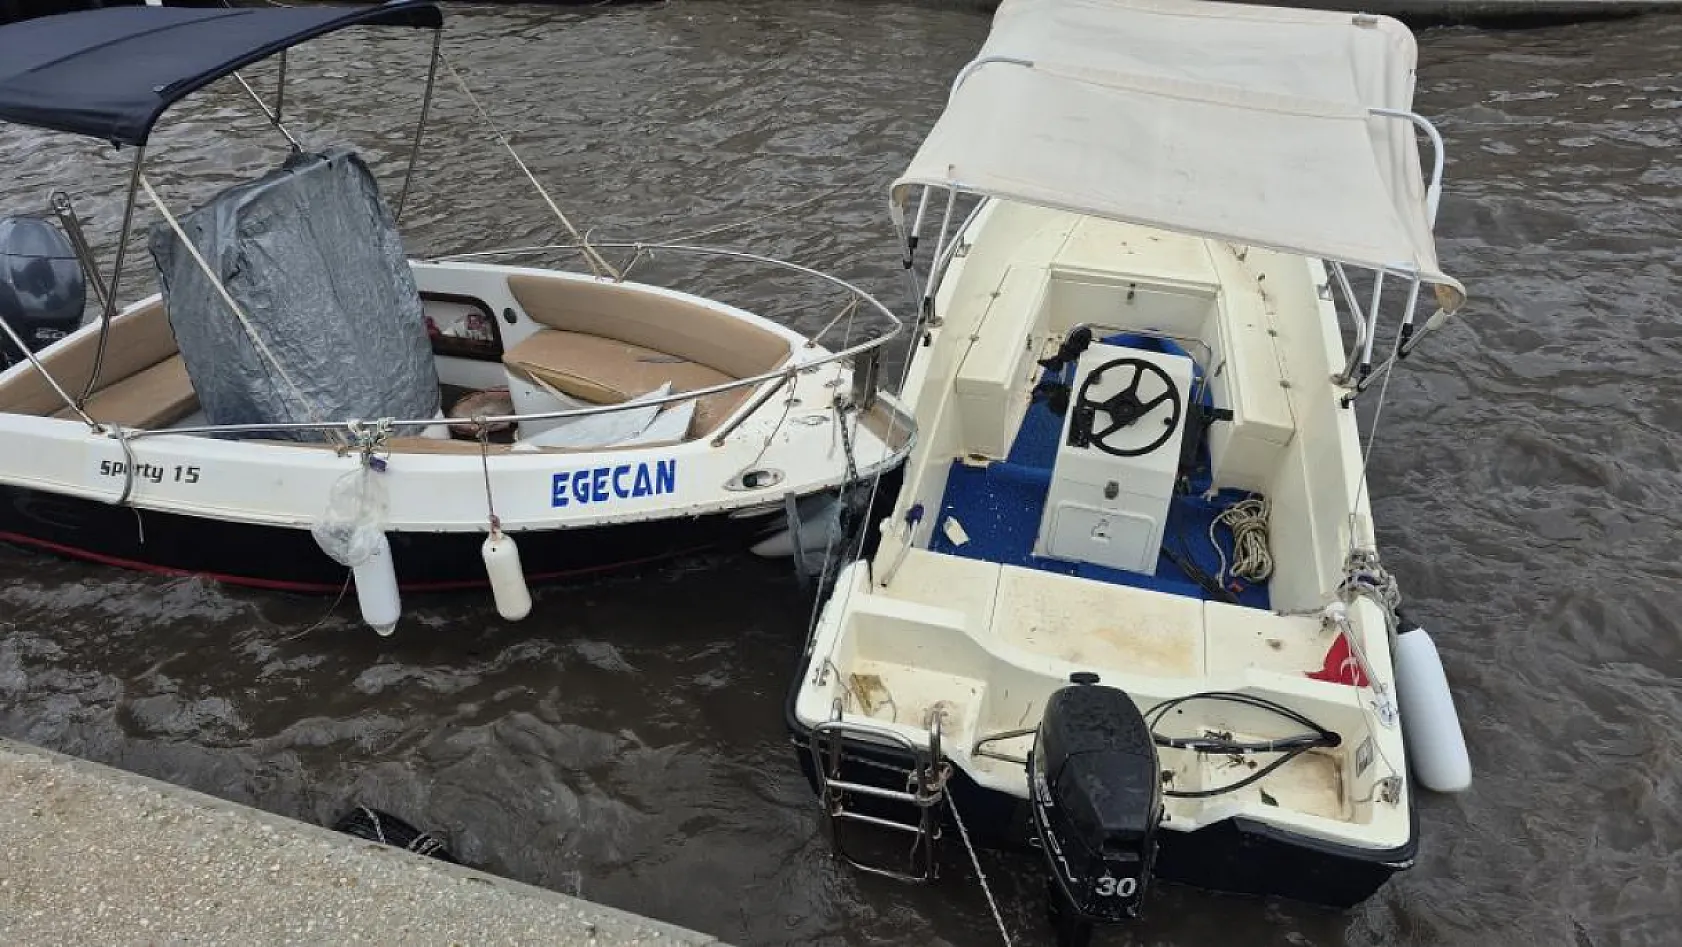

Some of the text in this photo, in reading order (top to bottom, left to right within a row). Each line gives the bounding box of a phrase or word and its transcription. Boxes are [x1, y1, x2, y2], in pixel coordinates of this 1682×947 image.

[174, 465, 200, 484] 15
[552, 459, 676, 507] EGECAN
[1095, 877, 1136, 896] 30
